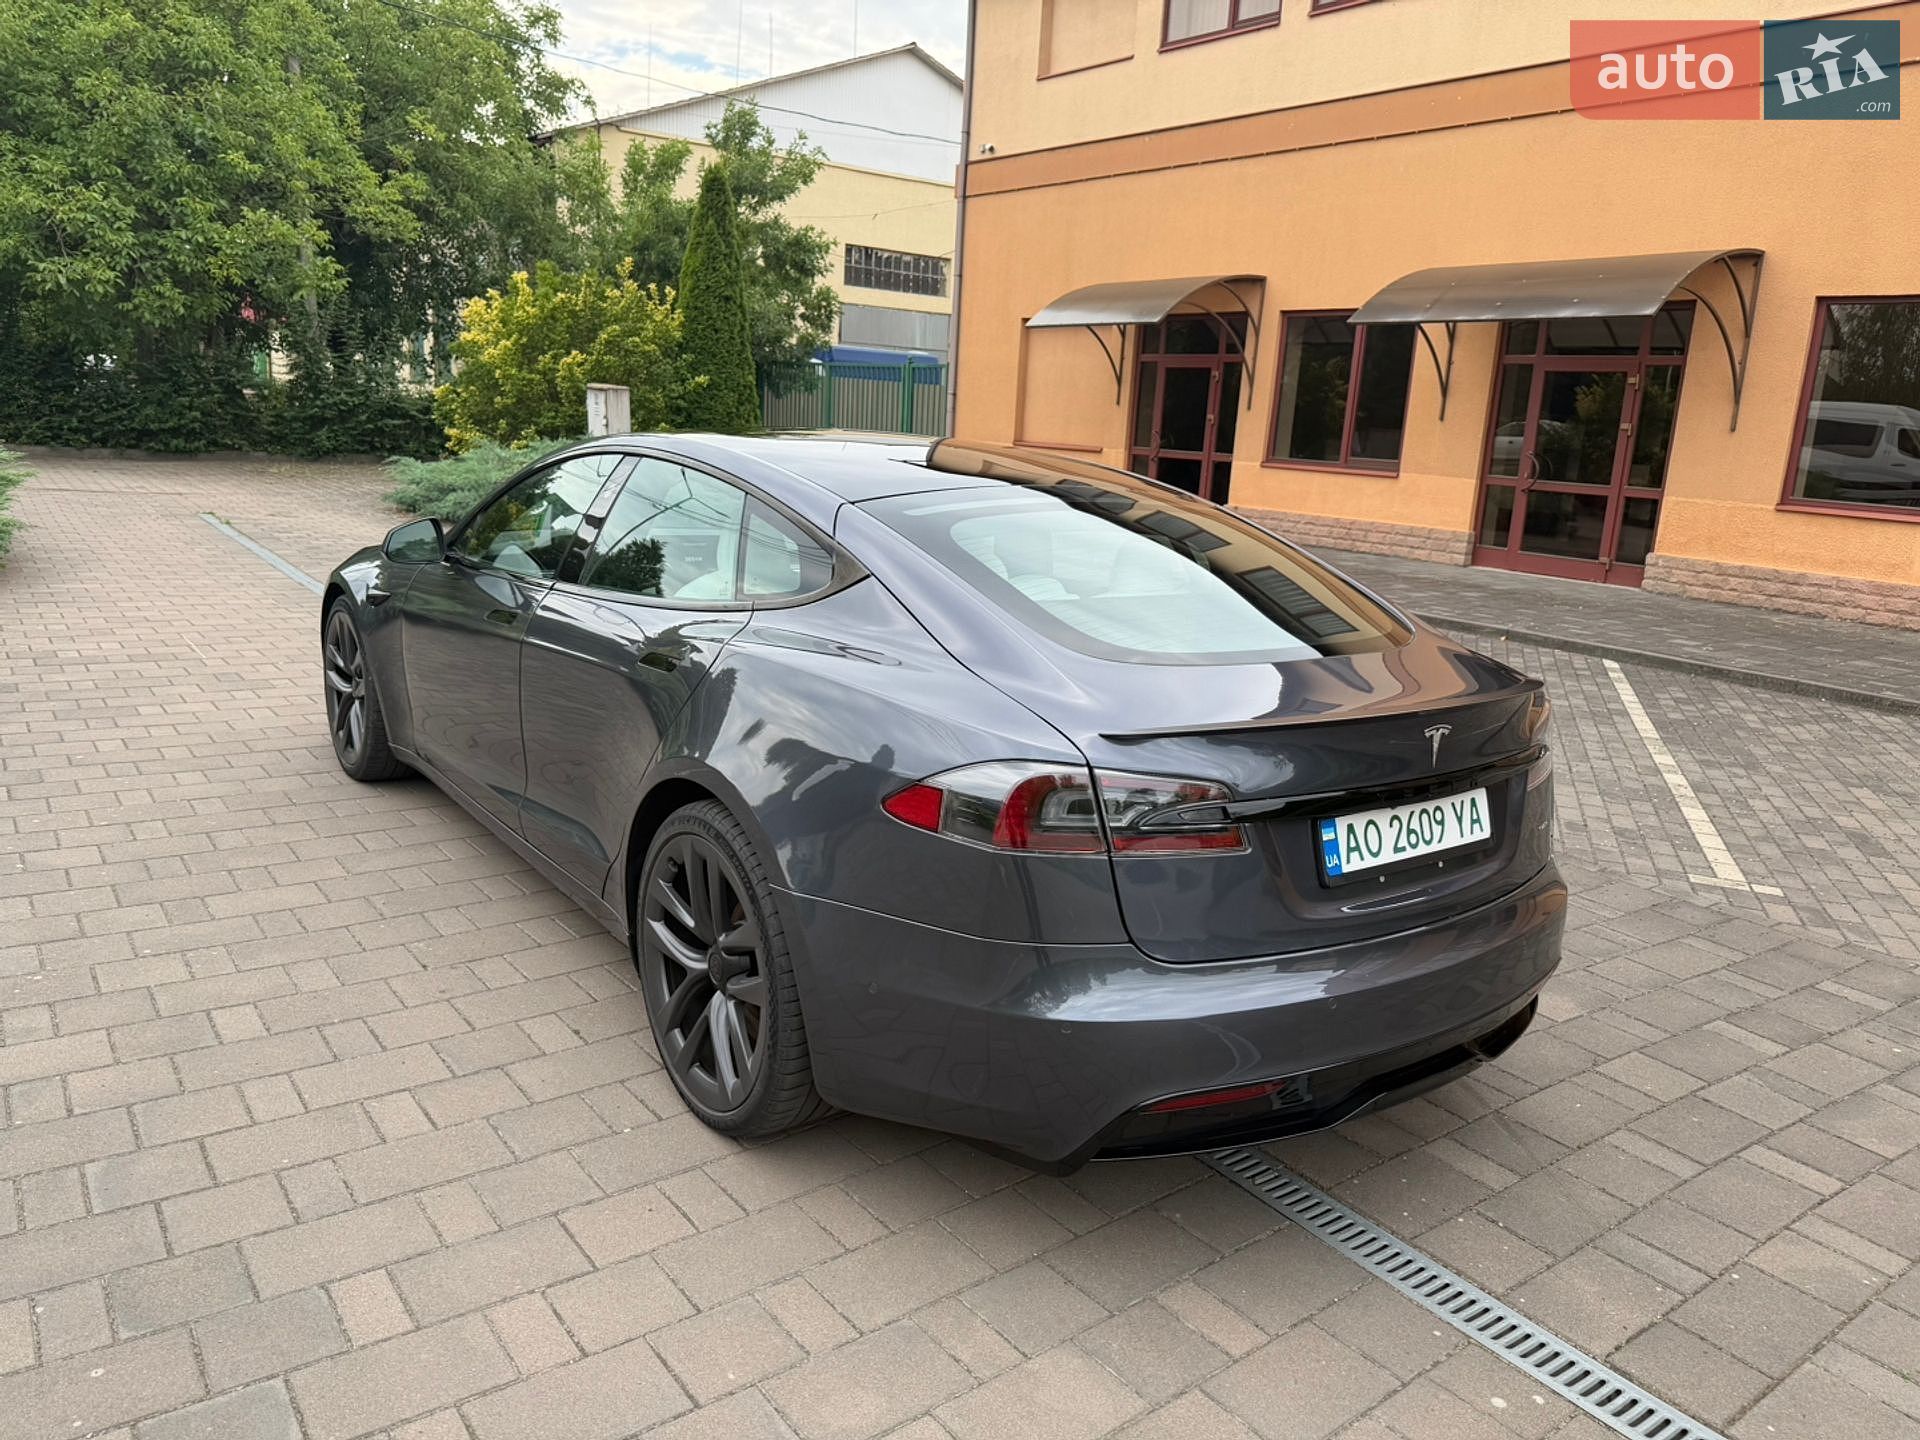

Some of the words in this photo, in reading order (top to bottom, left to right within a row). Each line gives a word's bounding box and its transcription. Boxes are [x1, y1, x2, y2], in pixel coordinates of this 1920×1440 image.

[1346, 819, 1383, 864] AO
[1389, 805, 1445, 854] 2609
[1451, 797, 1484, 838] YA
[1325, 854, 1340, 868] UA
